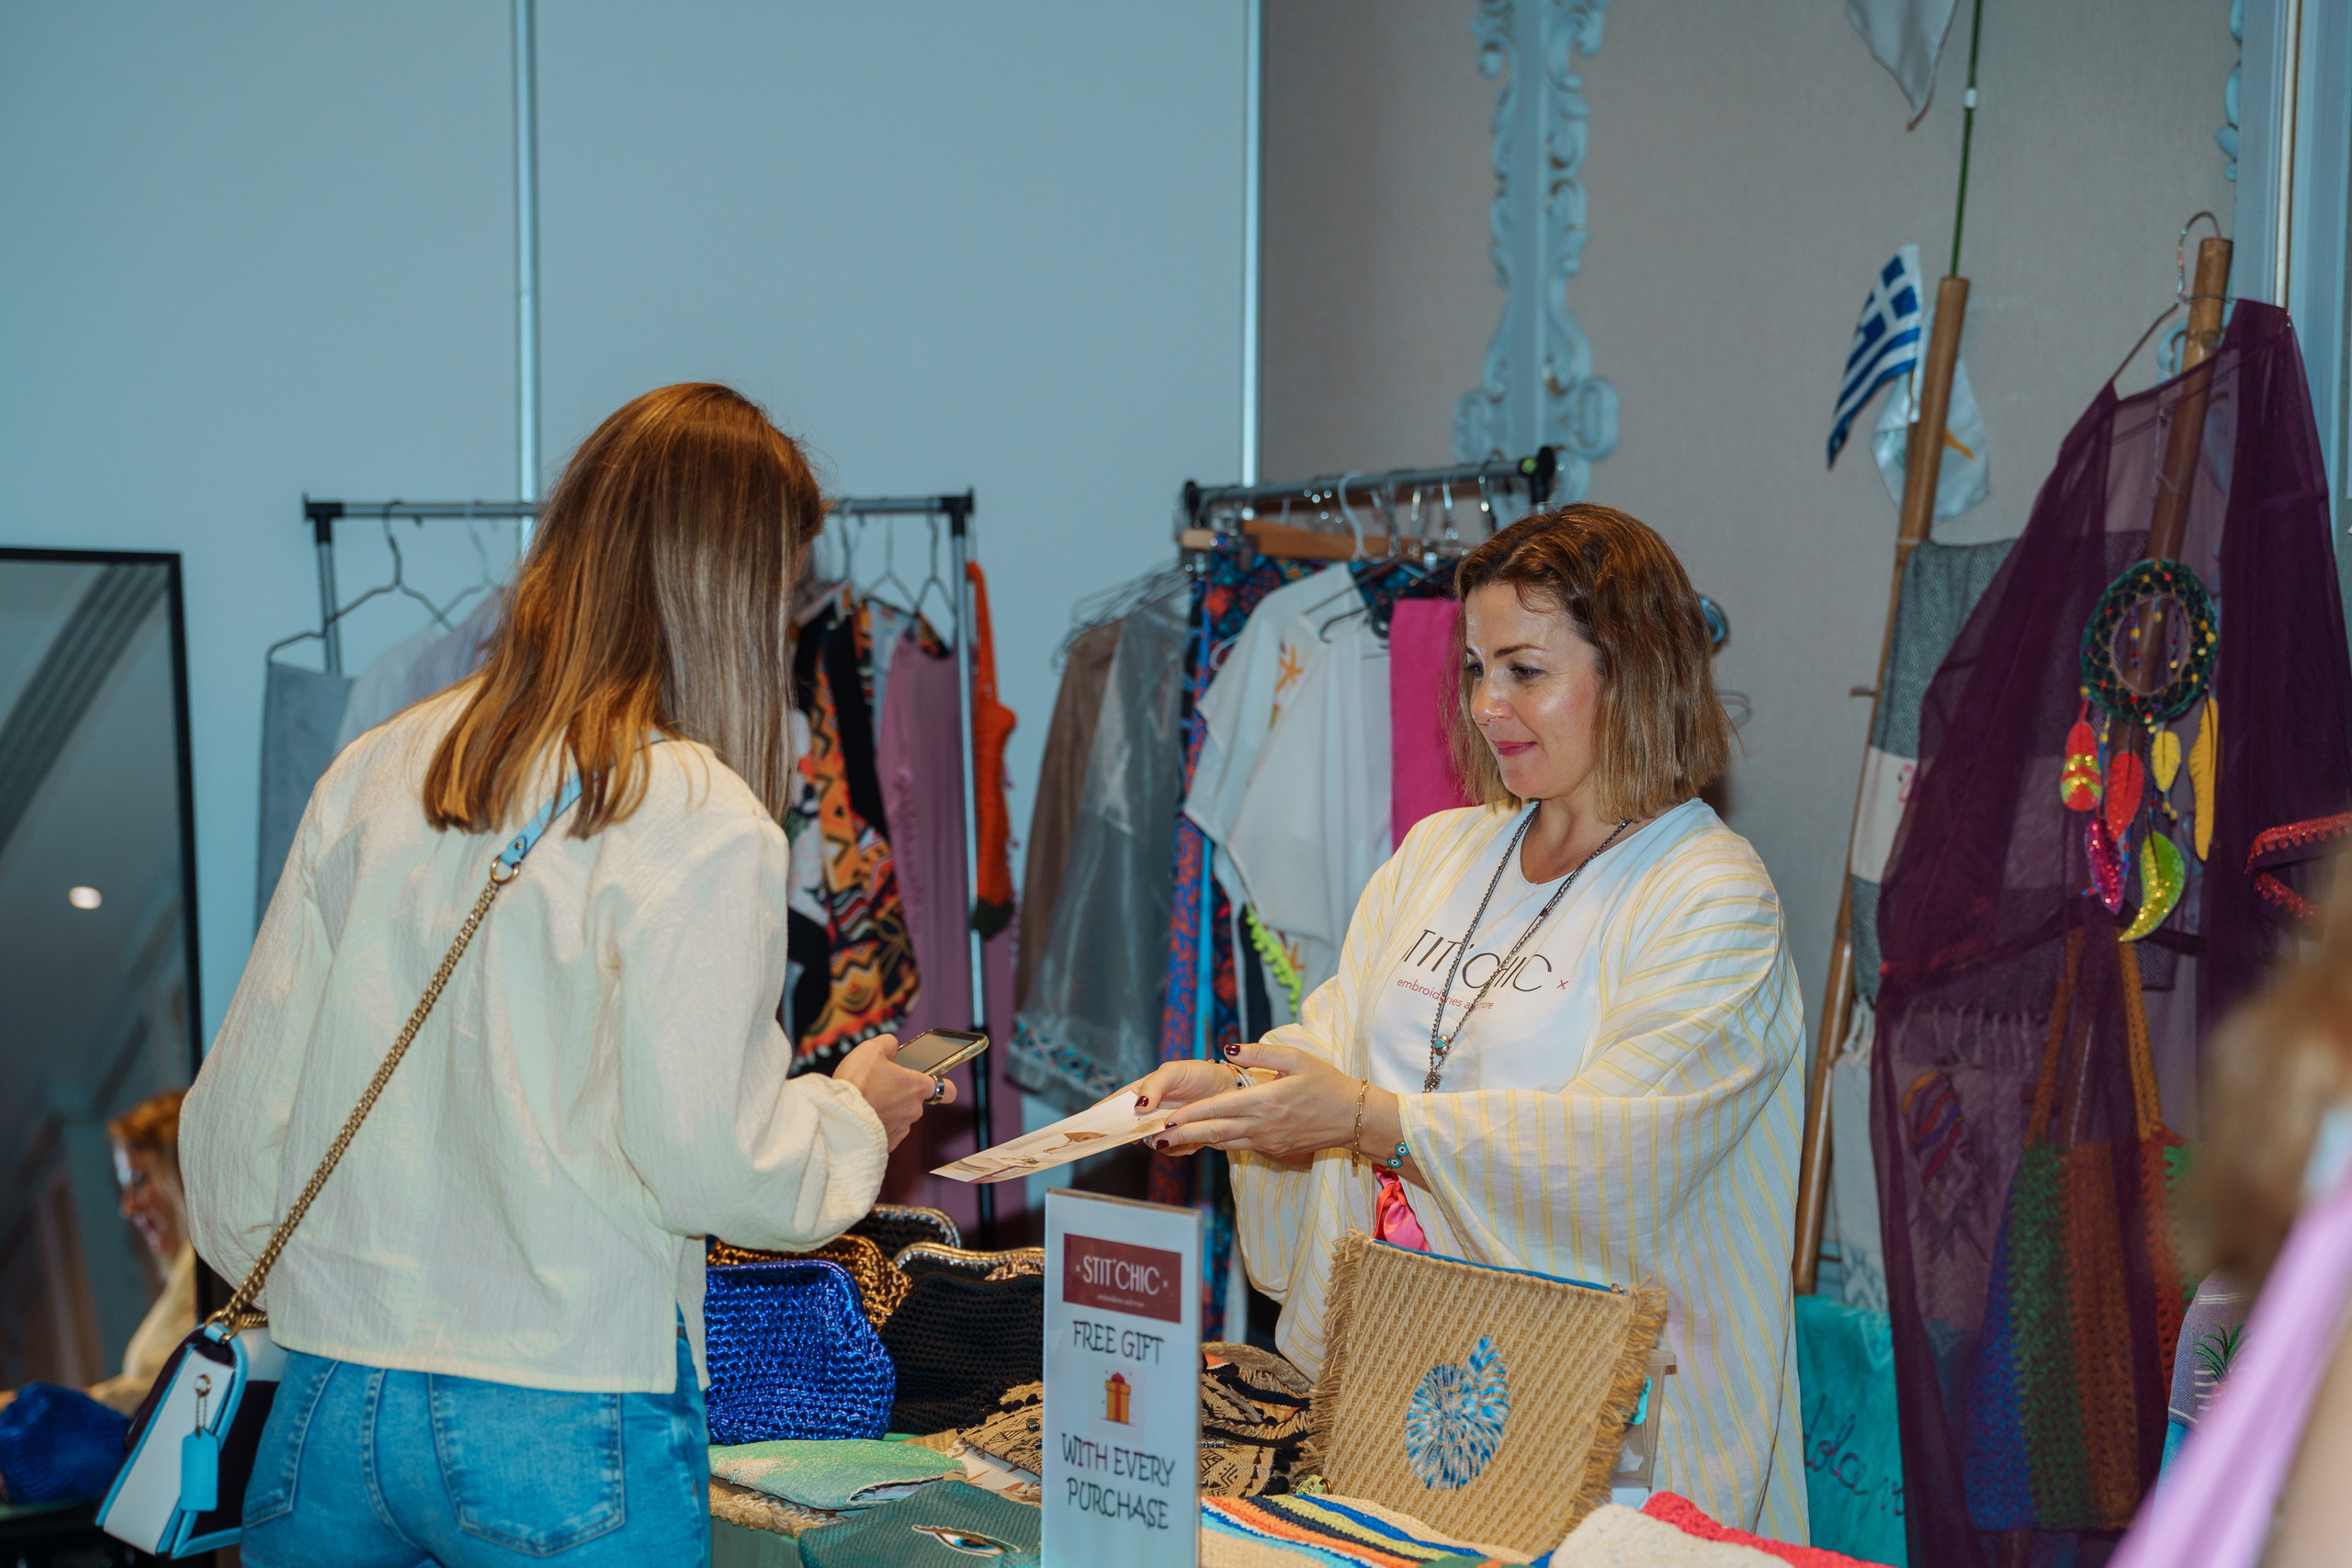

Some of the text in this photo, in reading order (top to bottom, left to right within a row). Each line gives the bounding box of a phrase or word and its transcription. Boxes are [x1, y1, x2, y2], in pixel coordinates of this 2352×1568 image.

[1403, 929, 1552, 992] TIT'CHIC
[1396, 979, 1463, 1008] embroidries
[1072, 1320, 1165, 1365] FREE GIFT
[1061, 1432, 1176, 1488] WITH EVERY
[1066, 1476, 1170, 1529] PURCHASE
